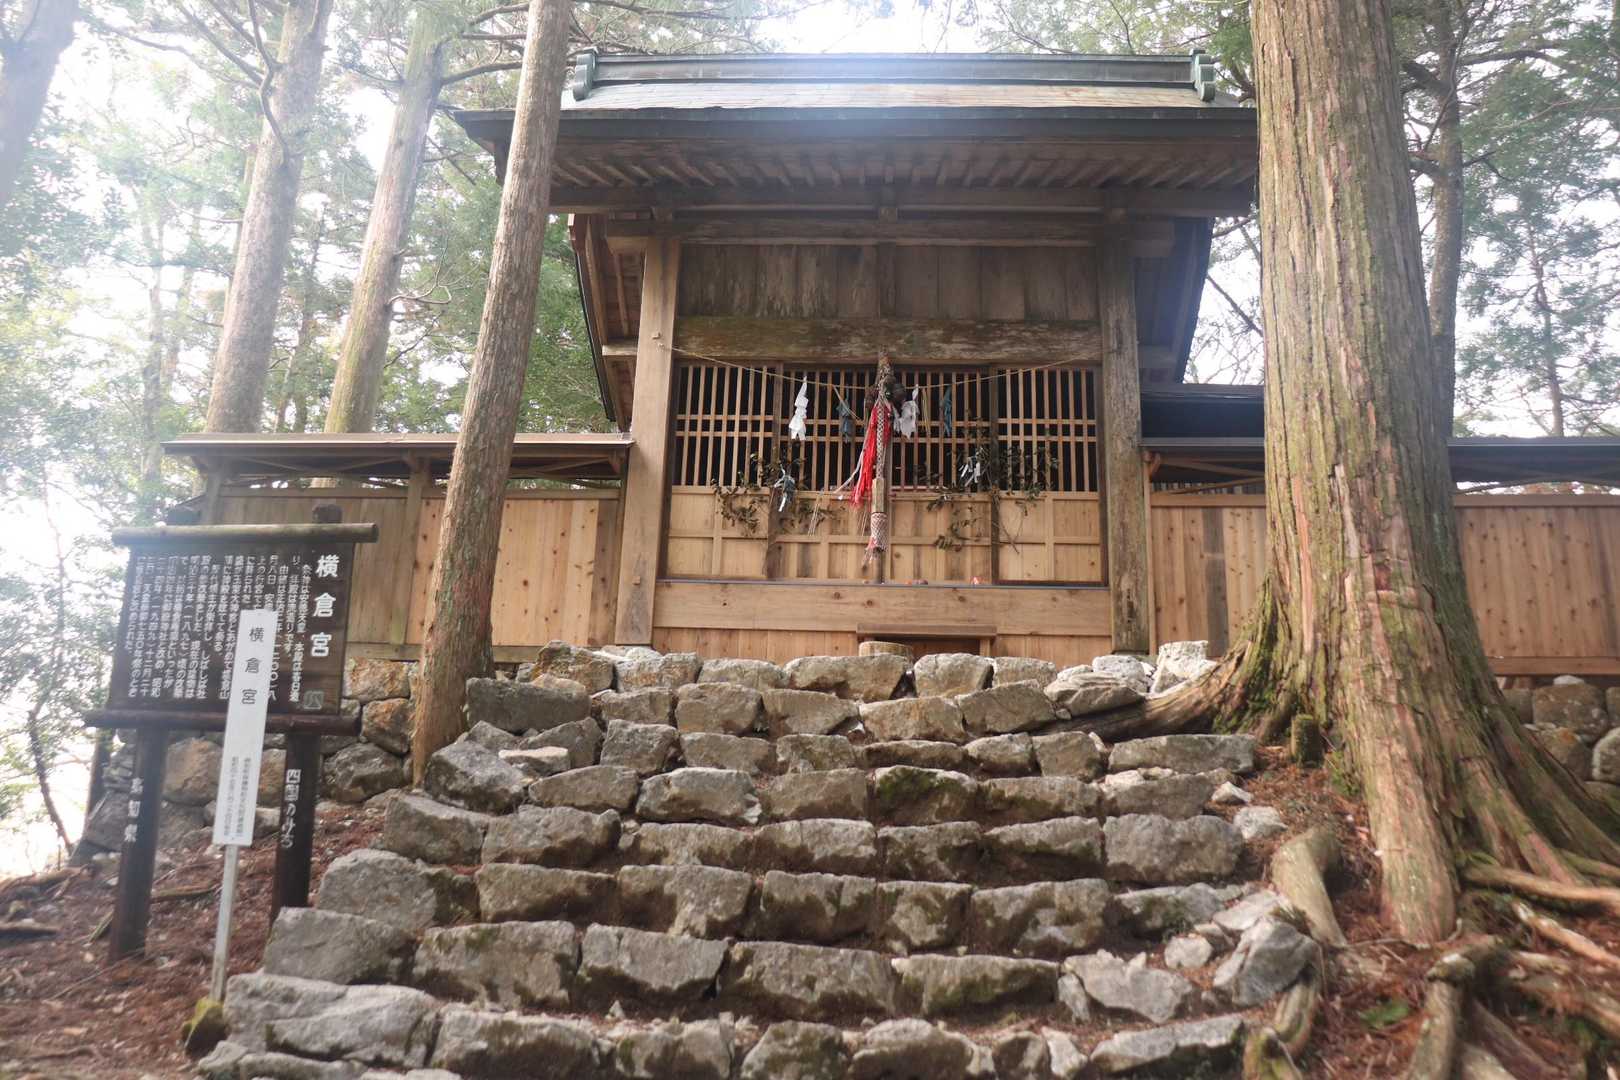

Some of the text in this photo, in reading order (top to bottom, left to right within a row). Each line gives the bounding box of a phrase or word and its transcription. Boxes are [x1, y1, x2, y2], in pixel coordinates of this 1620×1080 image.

[310, 554, 339, 657] 横倉宮
[241, 627, 265, 705] 横倉宮
[281, 768, 301, 848] 四国のみち
